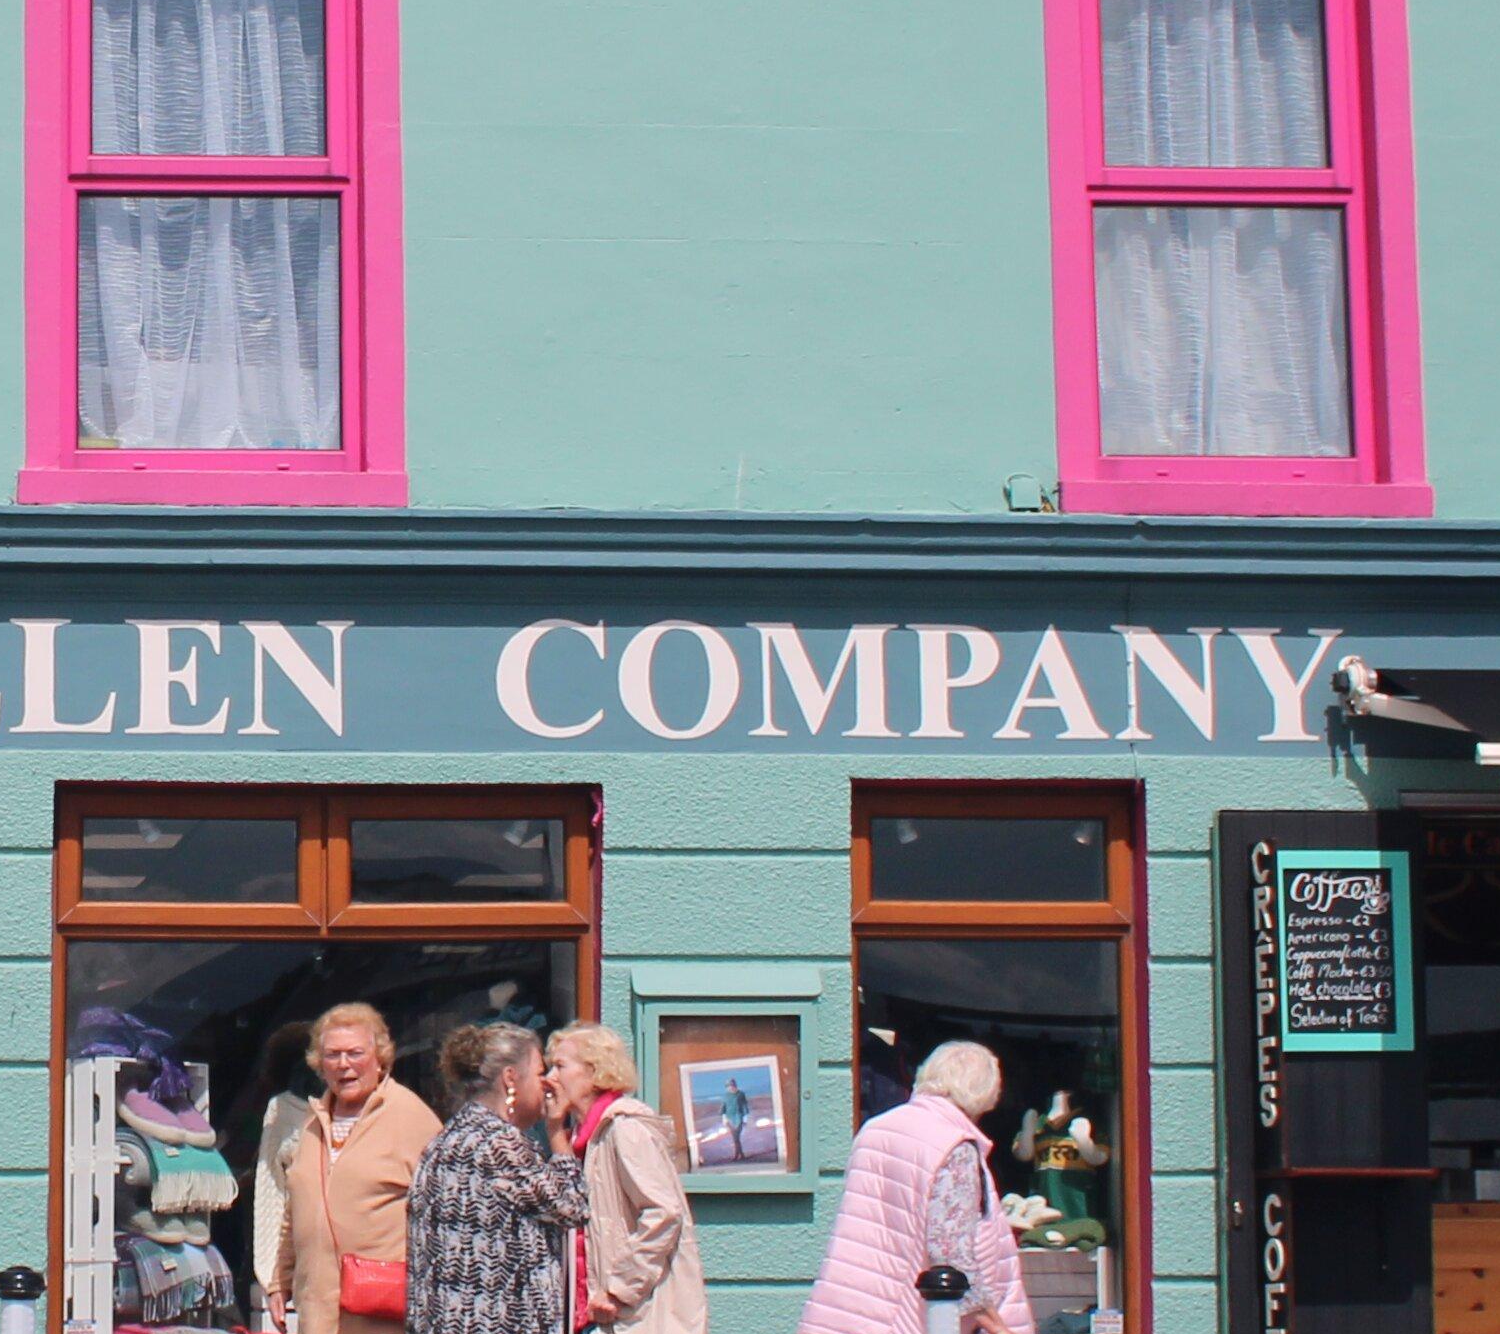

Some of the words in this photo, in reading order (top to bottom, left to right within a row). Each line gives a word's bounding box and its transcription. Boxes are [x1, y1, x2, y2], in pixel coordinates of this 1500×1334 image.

[494, 618, 1344, 741] COMPANY
[1290, 872, 1374, 913] Coffee
[1288, 913, 1343, 930] Espresso
[1287, 932, 1351, 946] Americano
[1289, 981, 1312, 997] Hot
[1290, 1002, 1338, 1028] Selection
[1340, 1007, 1352, 1028] of
